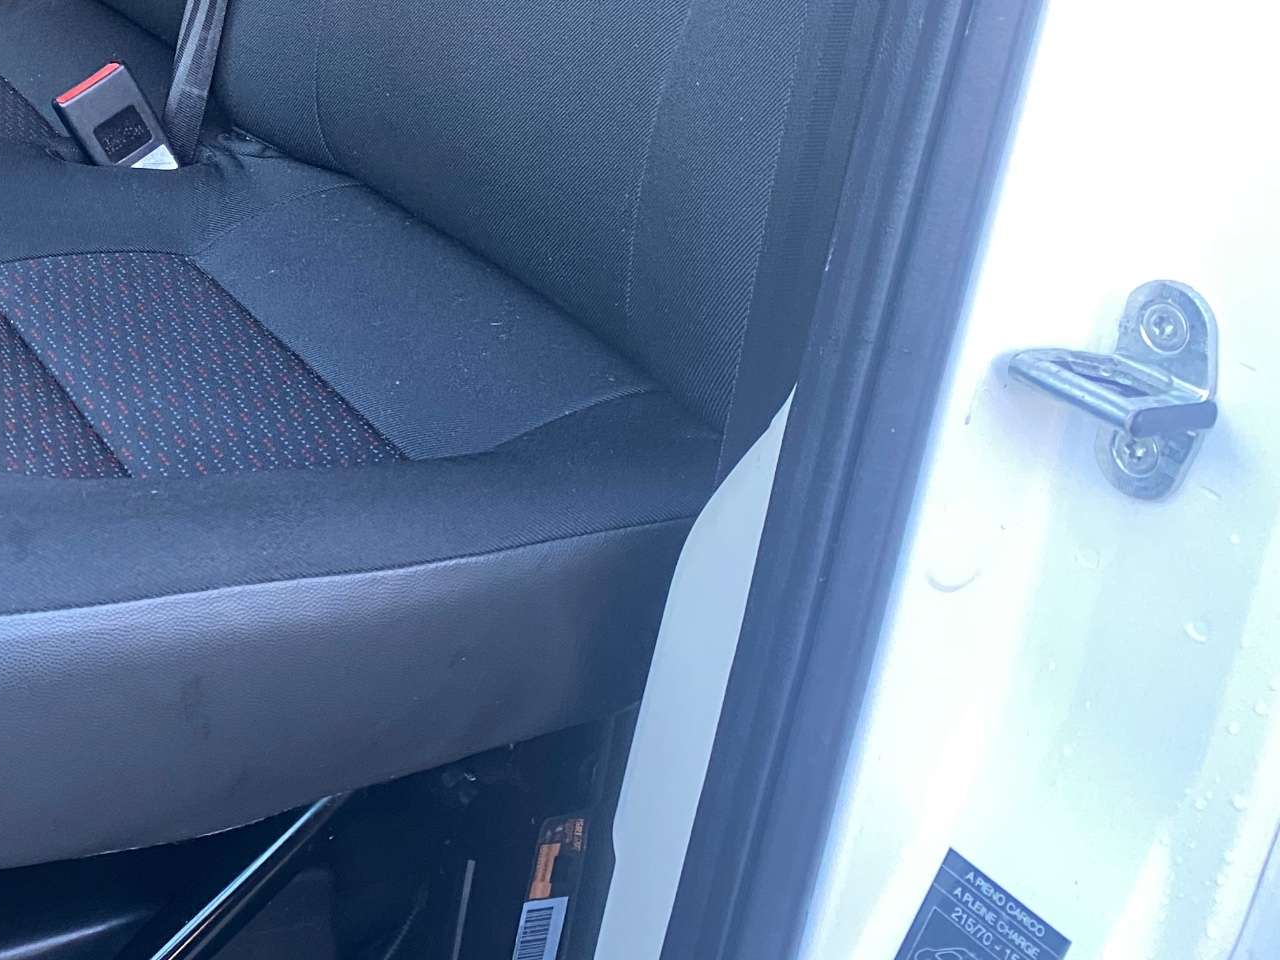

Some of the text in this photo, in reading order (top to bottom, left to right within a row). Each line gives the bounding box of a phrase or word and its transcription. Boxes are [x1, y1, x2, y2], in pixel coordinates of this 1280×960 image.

[951, 907, 993, 945] 215/70
[1006, 903, 1045, 937] CARICO
[997, 921, 1040, 960] CHARGE
